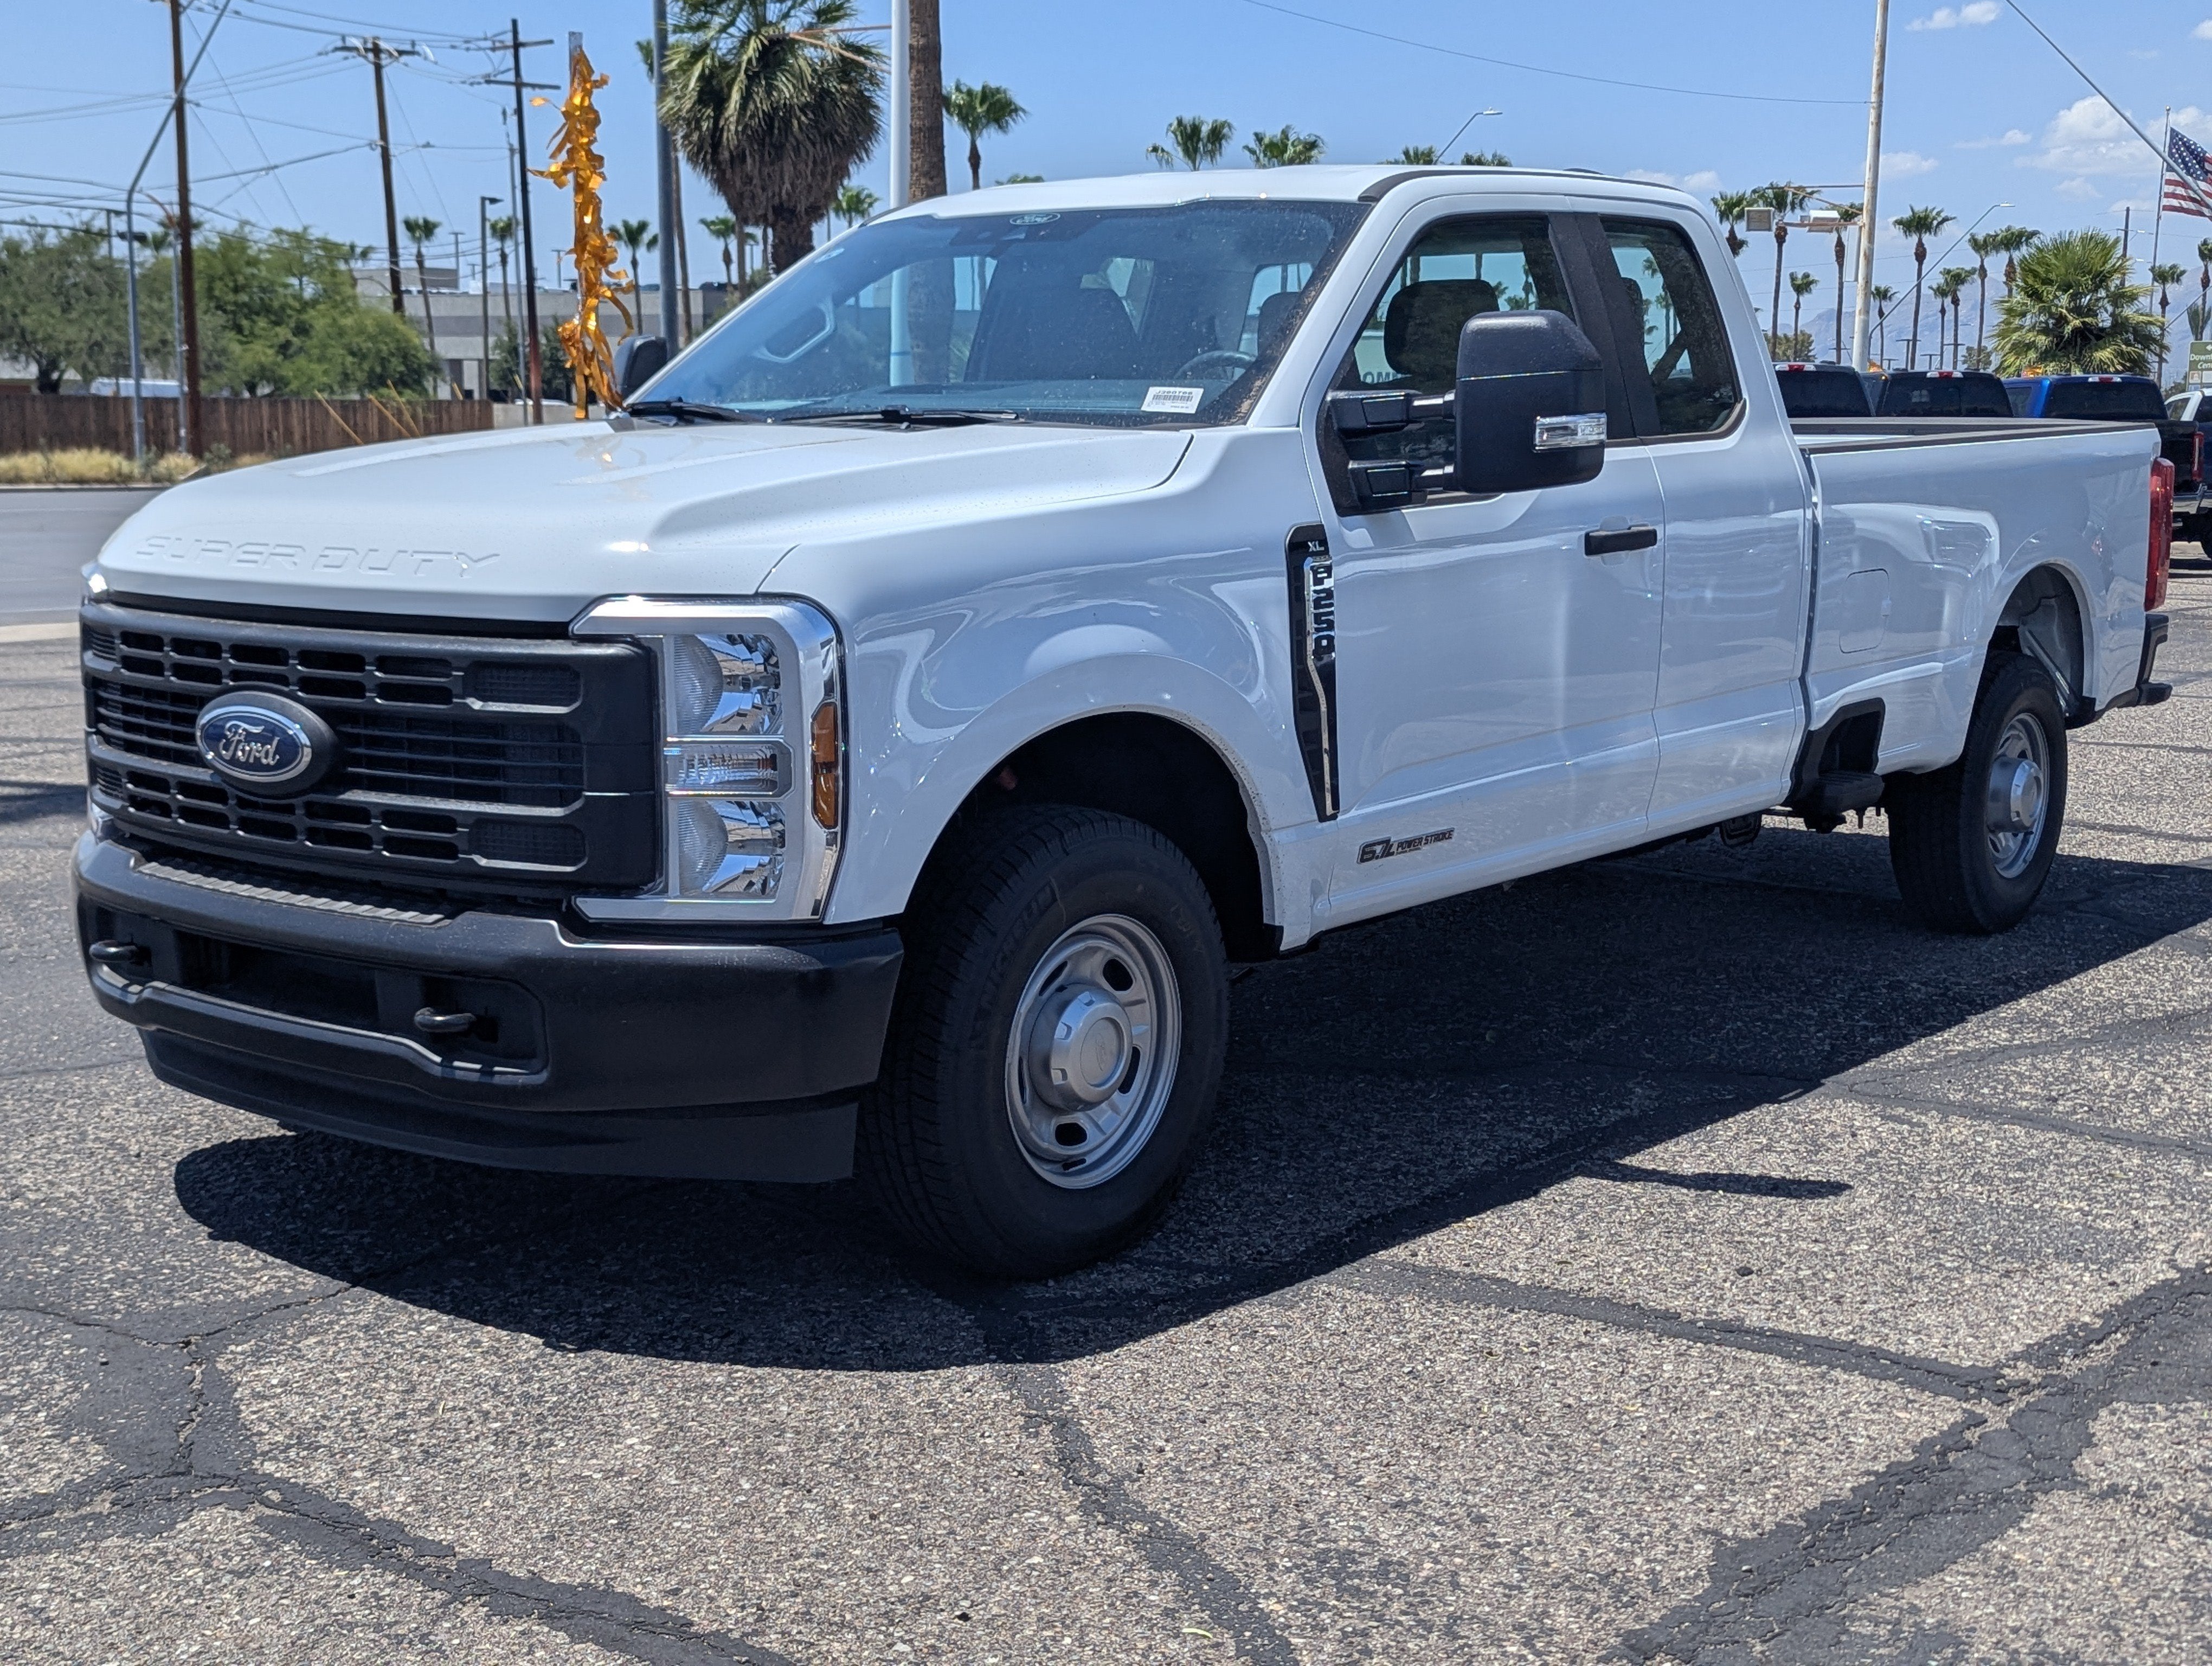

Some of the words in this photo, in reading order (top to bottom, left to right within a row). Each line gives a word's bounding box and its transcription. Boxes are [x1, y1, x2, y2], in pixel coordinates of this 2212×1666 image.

[136, 536, 306, 568] SUPER
[312, 546, 500, 578] DUTY
[1307, 541, 1324, 552] XL
[218, 720, 280, 766] Ford
[1397, 837, 1423, 851] POWER
[1423, 830, 1454, 845] STROKE
